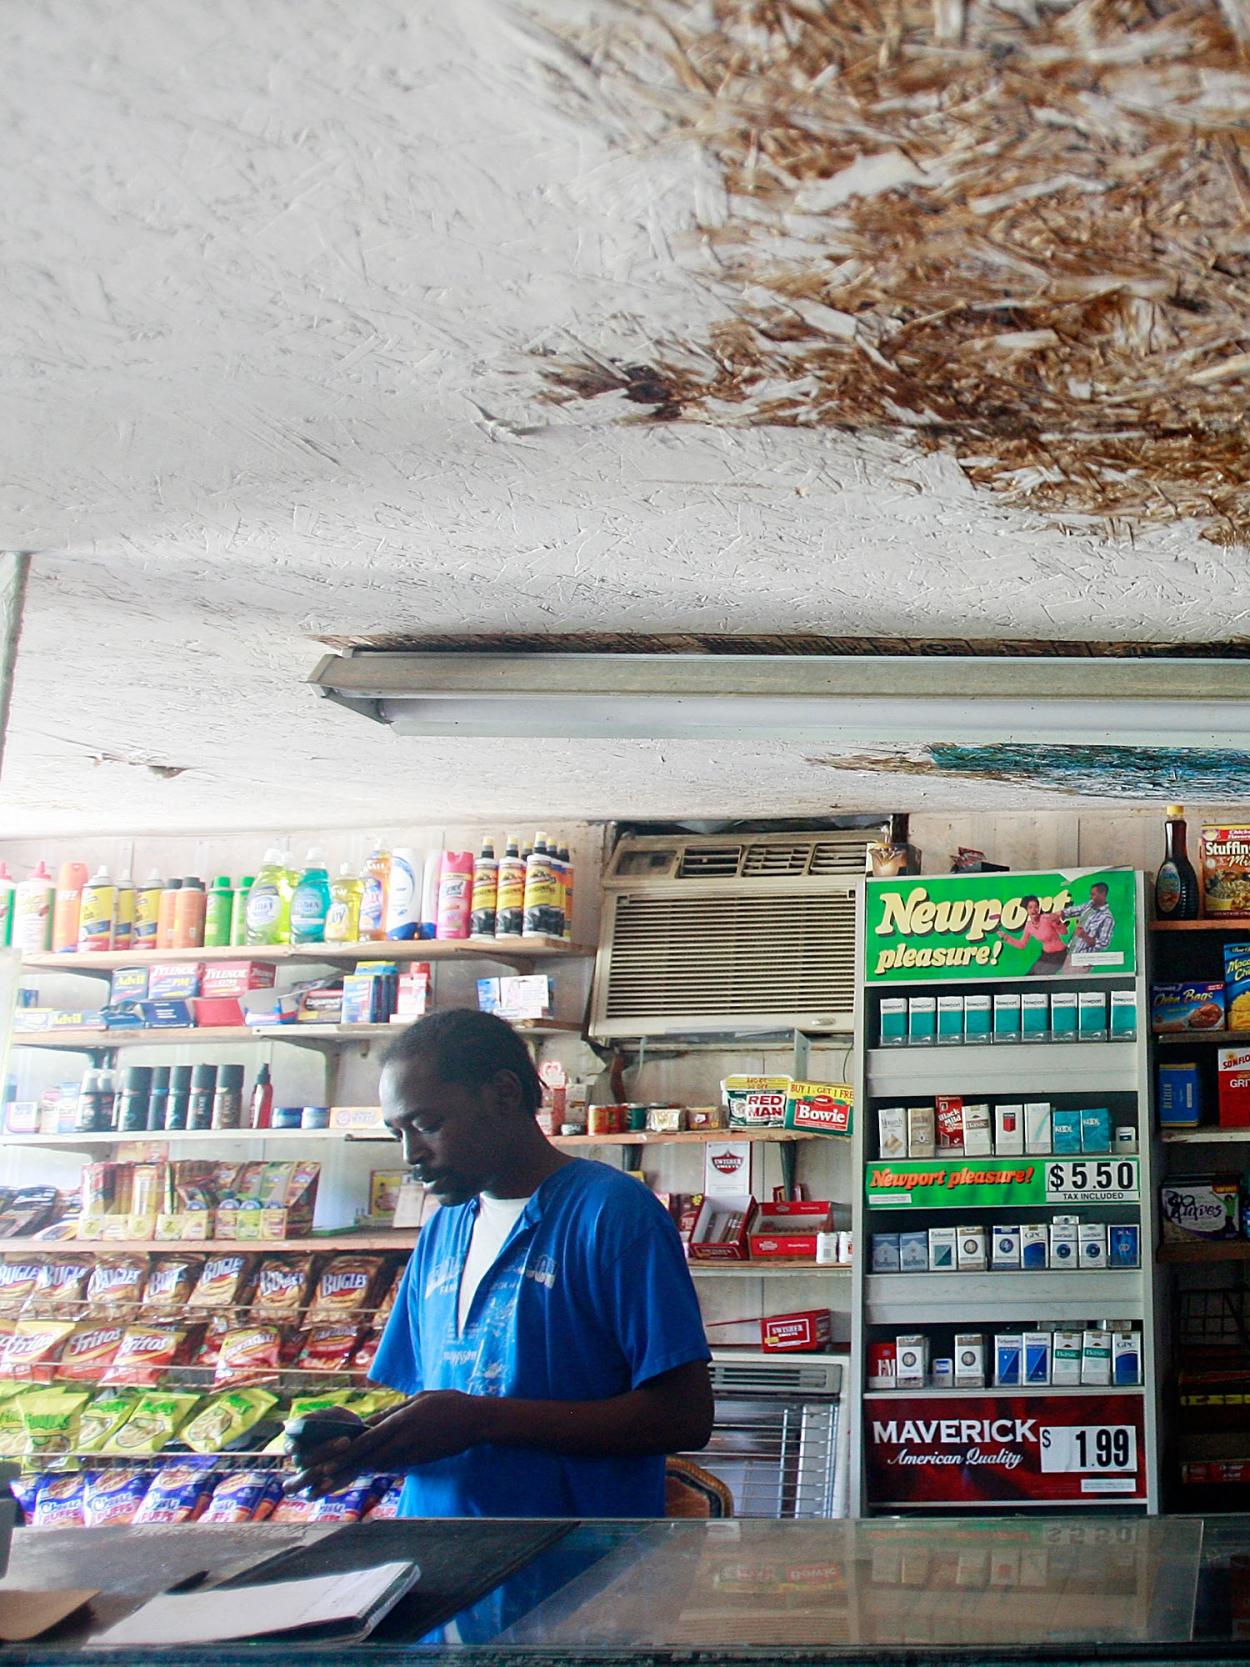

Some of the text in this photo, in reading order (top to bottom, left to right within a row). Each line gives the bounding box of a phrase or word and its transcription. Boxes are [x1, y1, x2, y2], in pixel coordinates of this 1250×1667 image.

[875, 887, 1072, 941] Newport
[874, 940, 1004, 974] pleasure!
[153, 965, 196, 977] TYLENOL
[206, 968, 247, 980] TYLENOL
[117, 975, 145, 986] Advil
[1183, 989, 1214, 1003] Bags
[55, 1013, 82, 1025] Advil
[790, 1084, 806, 1094] BUY
[817, 1087, 831, 1095] GET
[839, 1090, 854, 1099] FRE
[748, 1095, 782, 1106] RED
[748, 1107, 783, 1117] MAN
[798, 1104, 846, 1123] Bowie
[870, 1167, 1034, 1189] Newport pleasure!
[1081, 1192, 1124, 1200] INCLUDED
[323, 1272, 369, 1297] BUGLES
[772, 1324, 803, 1335] SWISHER
[70, 1327, 123, 1355] Fritos
[1056, 1350, 1078, 1358] Basic
[1085, 1349, 1107, 1357] Basic
[873, 1419, 1038, 1443] MAVERICK
[1075, 1428, 1129, 1468] 1.99
[888, 1447, 1023, 1469] American Quality
